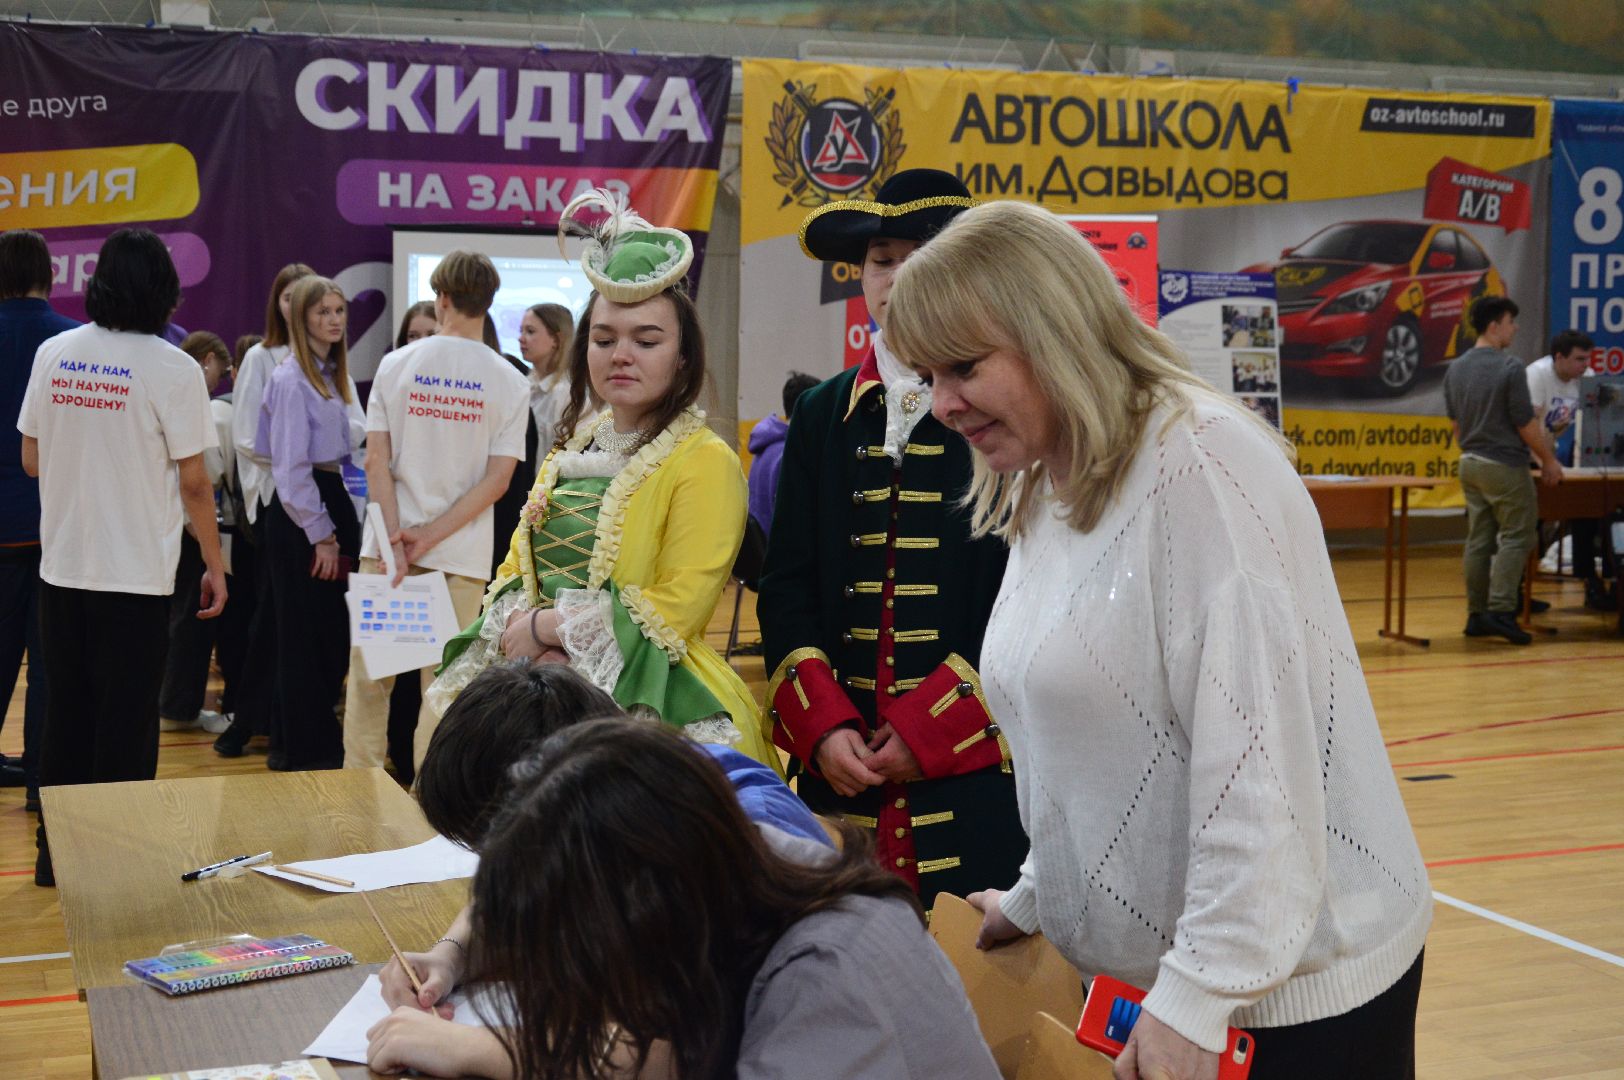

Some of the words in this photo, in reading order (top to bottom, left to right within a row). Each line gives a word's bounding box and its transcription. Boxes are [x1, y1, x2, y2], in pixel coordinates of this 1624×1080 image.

[27, 94, 108, 119] друга
[295, 57, 710, 152] СКИДКА
[950, 92, 1292, 153] АВТОШКОЛА
[1370, 105, 1505, 128] oz-avtoschool.ru
[0, 166, 137, 209] ения
[378, 171, 453, 210] НА
[466, 174, 631, 215] ЗАКАЗ
[1451, 172, 1514, 193] КАТЕГОРИИ
[59, 359, 87, 372] ИДИ
[90, 363, 100, 374] К
[1590, 347, 1624, 374] ЕО
[51, 377, 73, 389] МЫ
[75, 379, 130, 396] НАУЧИМ
[414, 374, 440, 386] ИДИ
[443, 378, 452, 388] К
[51, 393, 126, 412] ХОРОШЕМУ!
[409, 392, 431, 403] МЫ
[433, 394, 484, 409] НАУЧИМ
[408, 405, 482, 424] ХОРОШЕМУ!
